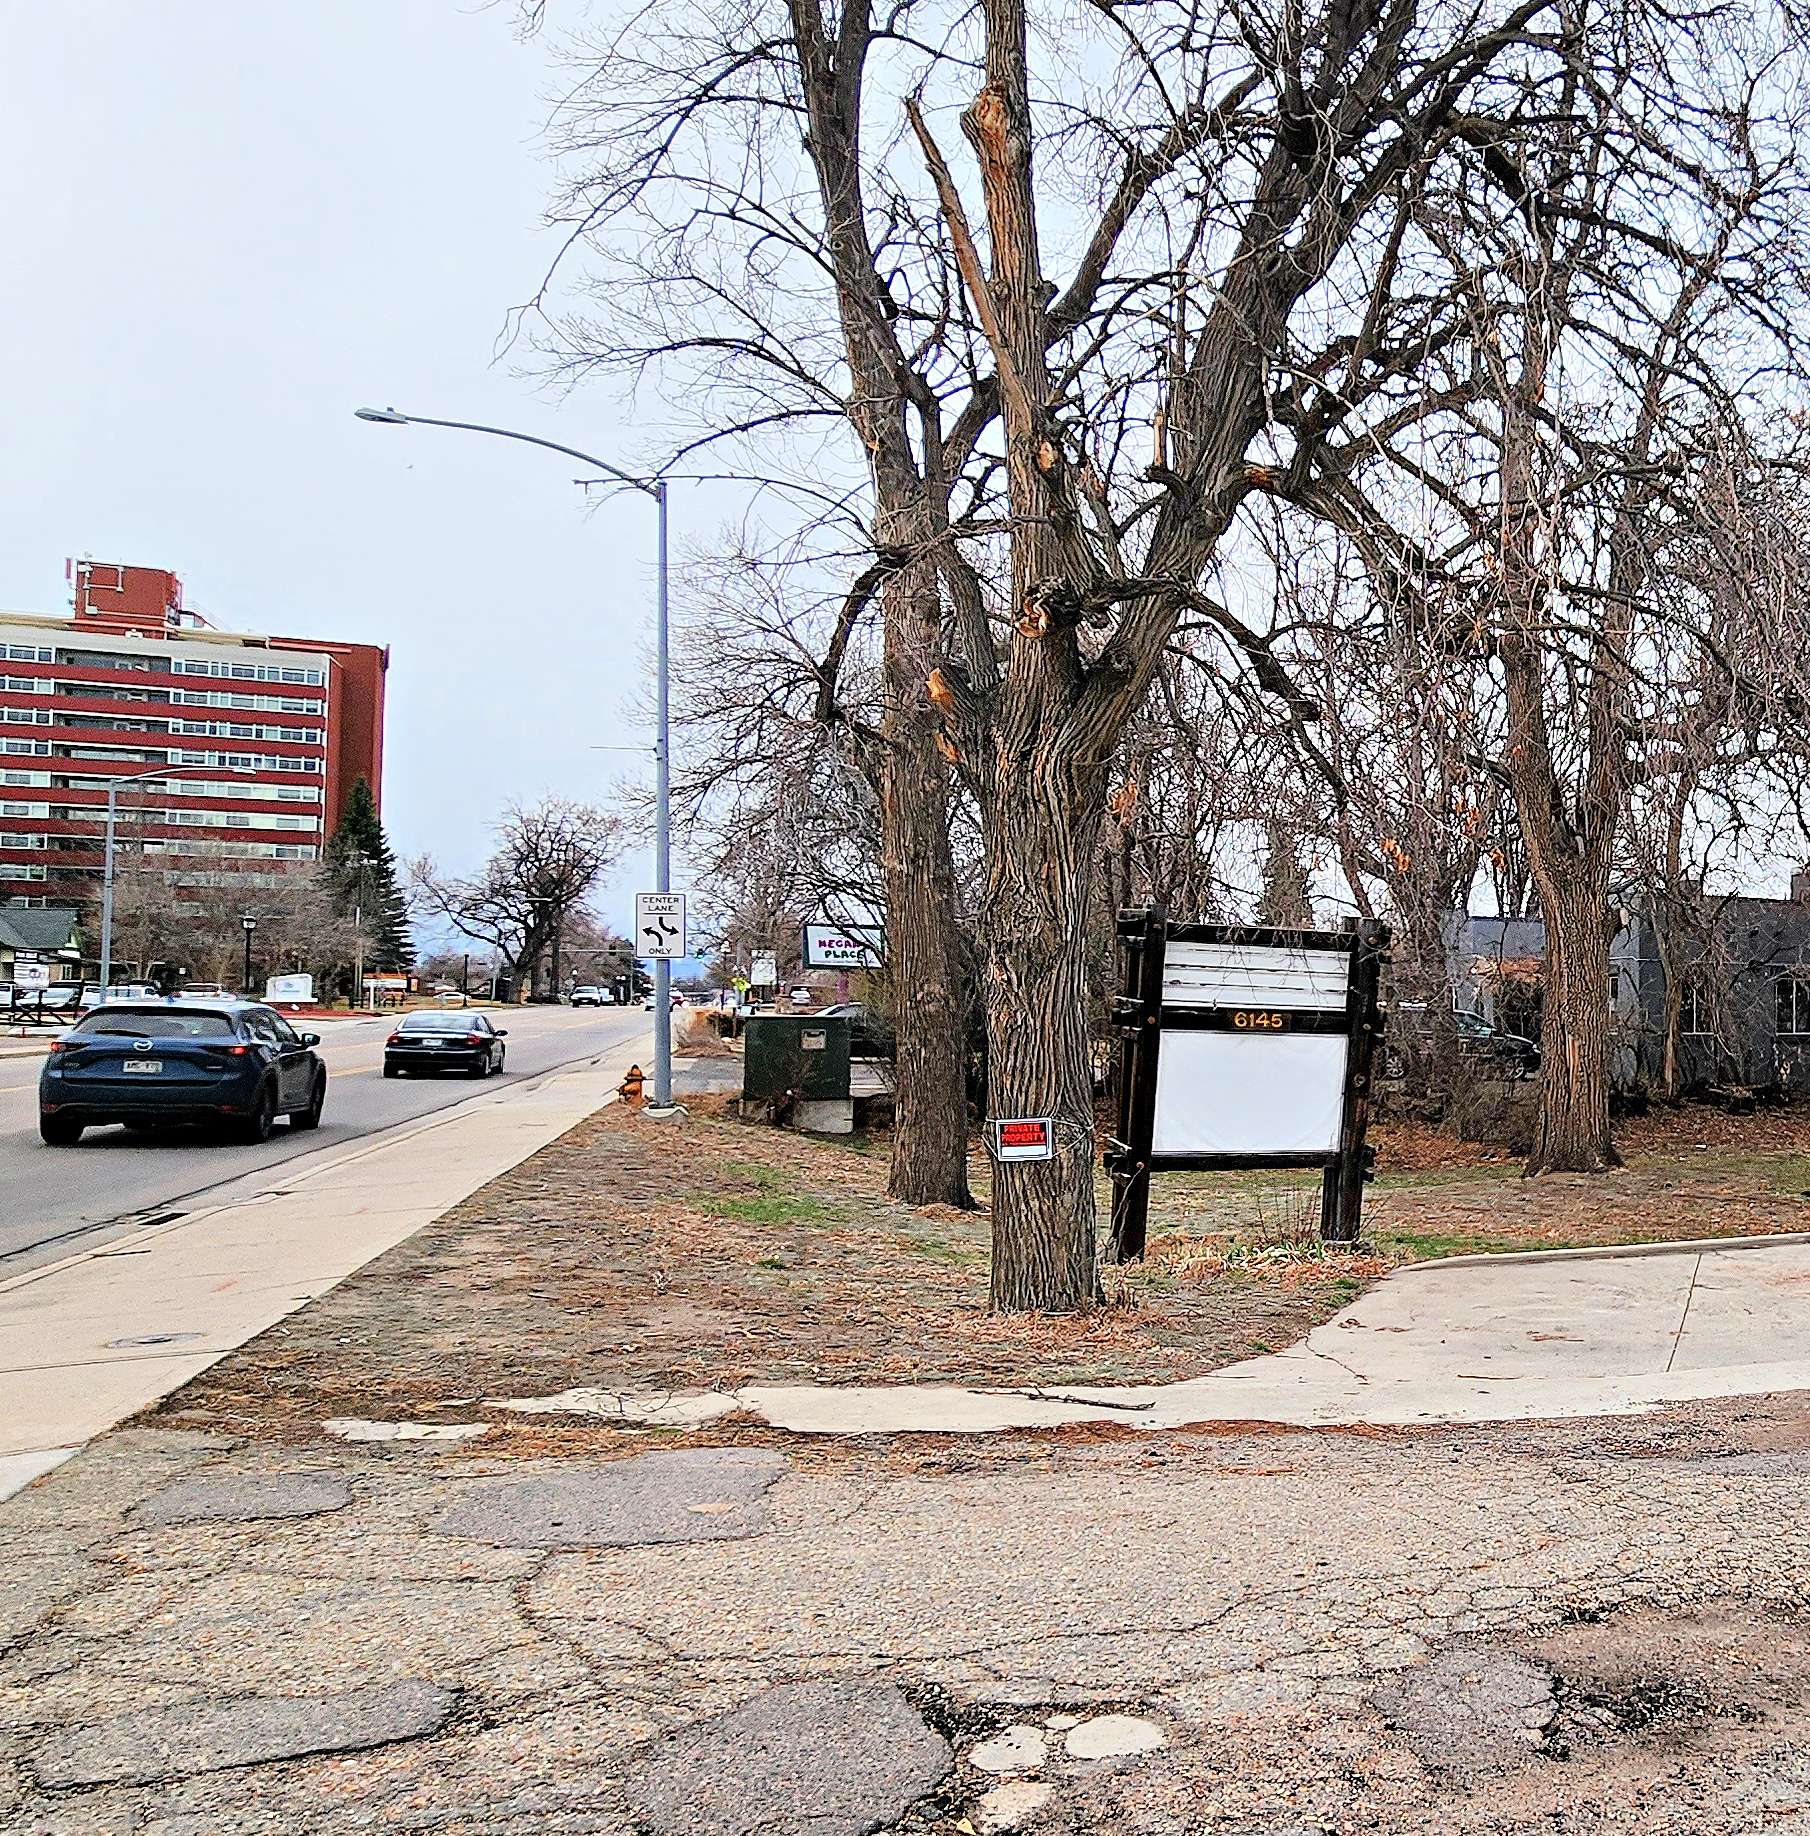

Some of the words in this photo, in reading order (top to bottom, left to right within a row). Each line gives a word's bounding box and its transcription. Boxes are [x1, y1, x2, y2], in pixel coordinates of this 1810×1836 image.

[642, 896, 680, 904] CENTER
[648, 947, 672, 955] ONLY
[824, 949, 865, 959] PLACE
[1233, 1011, 1283, 1028] 6145
[1003, 1123, 1041, 1133] PRIVATE
[1001, 1132, 1046, 1143] PROPERTY
